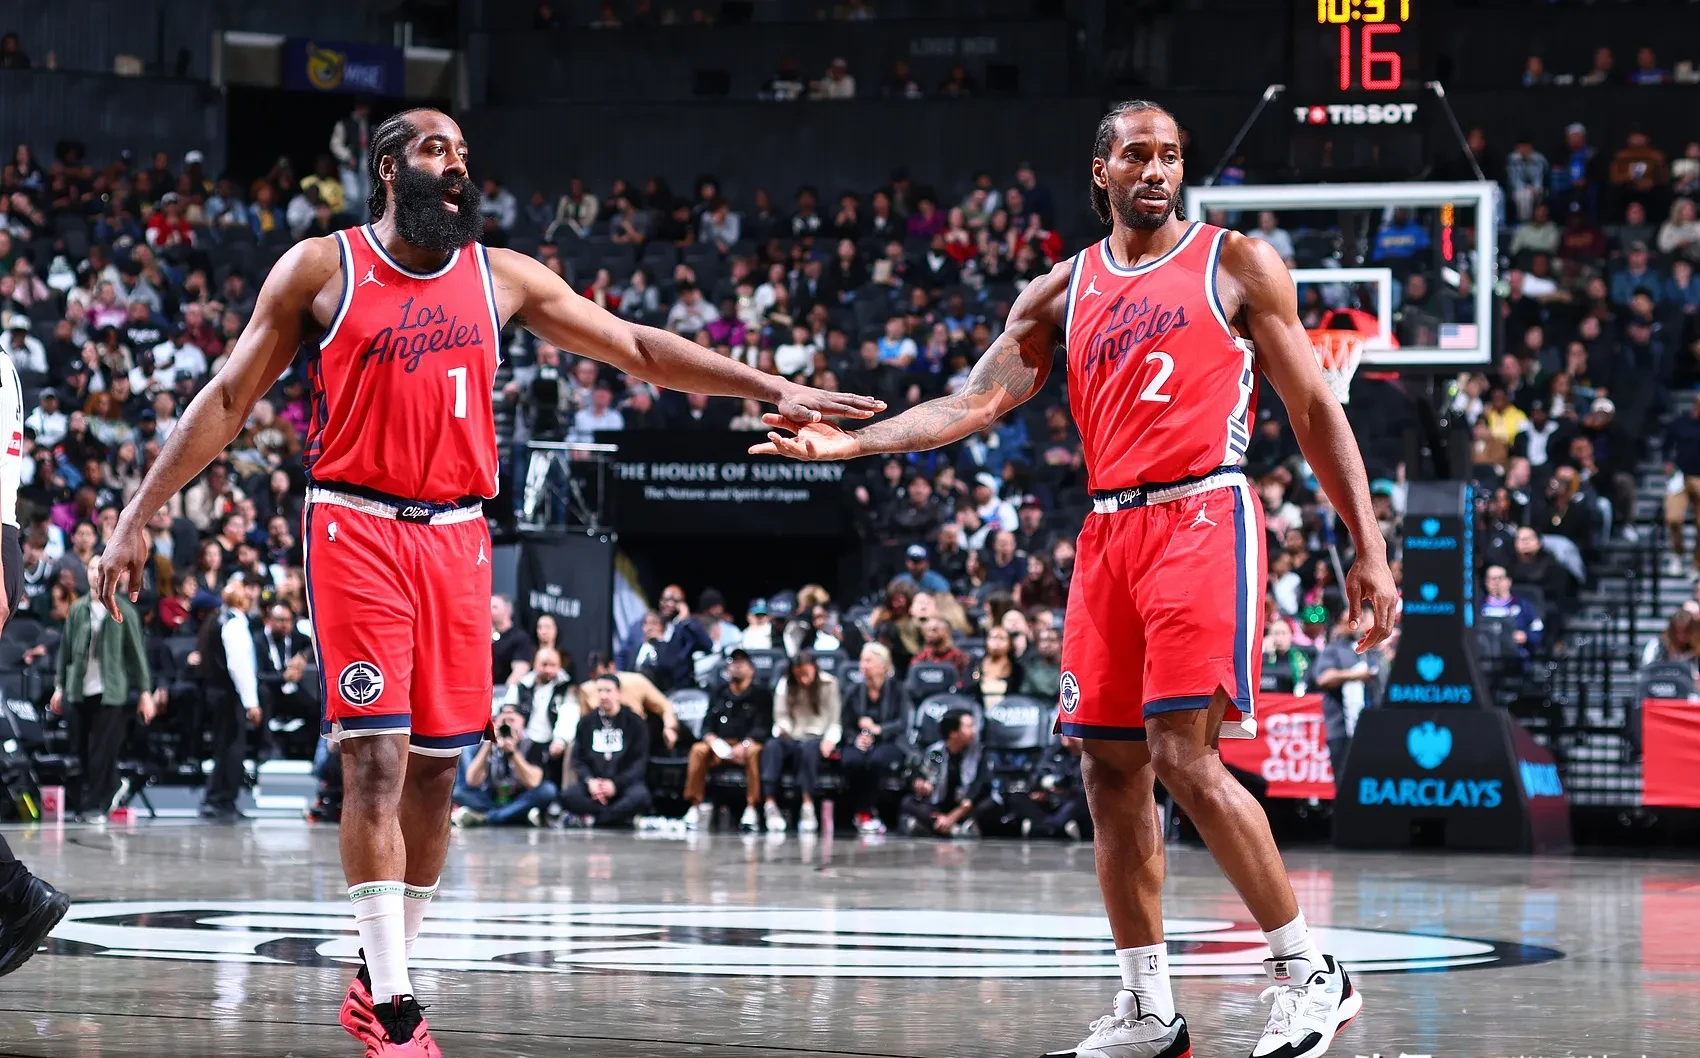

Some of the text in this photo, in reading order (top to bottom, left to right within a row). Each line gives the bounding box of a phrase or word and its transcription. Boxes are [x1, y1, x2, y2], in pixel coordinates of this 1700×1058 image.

[1340, 24, 1401, 91] 16
[1327, 103, 1418, 124] TISSOT
[398, 296, 448, 332] Los
[1105, 296, 1153, 334] Los
[361, 316, 483, 374] Angeles
[1085, 304, 1190, 382] Angeles
[447, 366, 467, 419] 1
[1140, 351, 1175, 403] 2
[613, 463, 845, 482] THE HOUSE OF SUNTORY
[402, 506, 429, 518] Clips
[1389, 684, 1472, 704] BARCLAYS
[1265, 713, 1326, 737] GET
[1358, 777, 1502, 808] BARCLAYS
